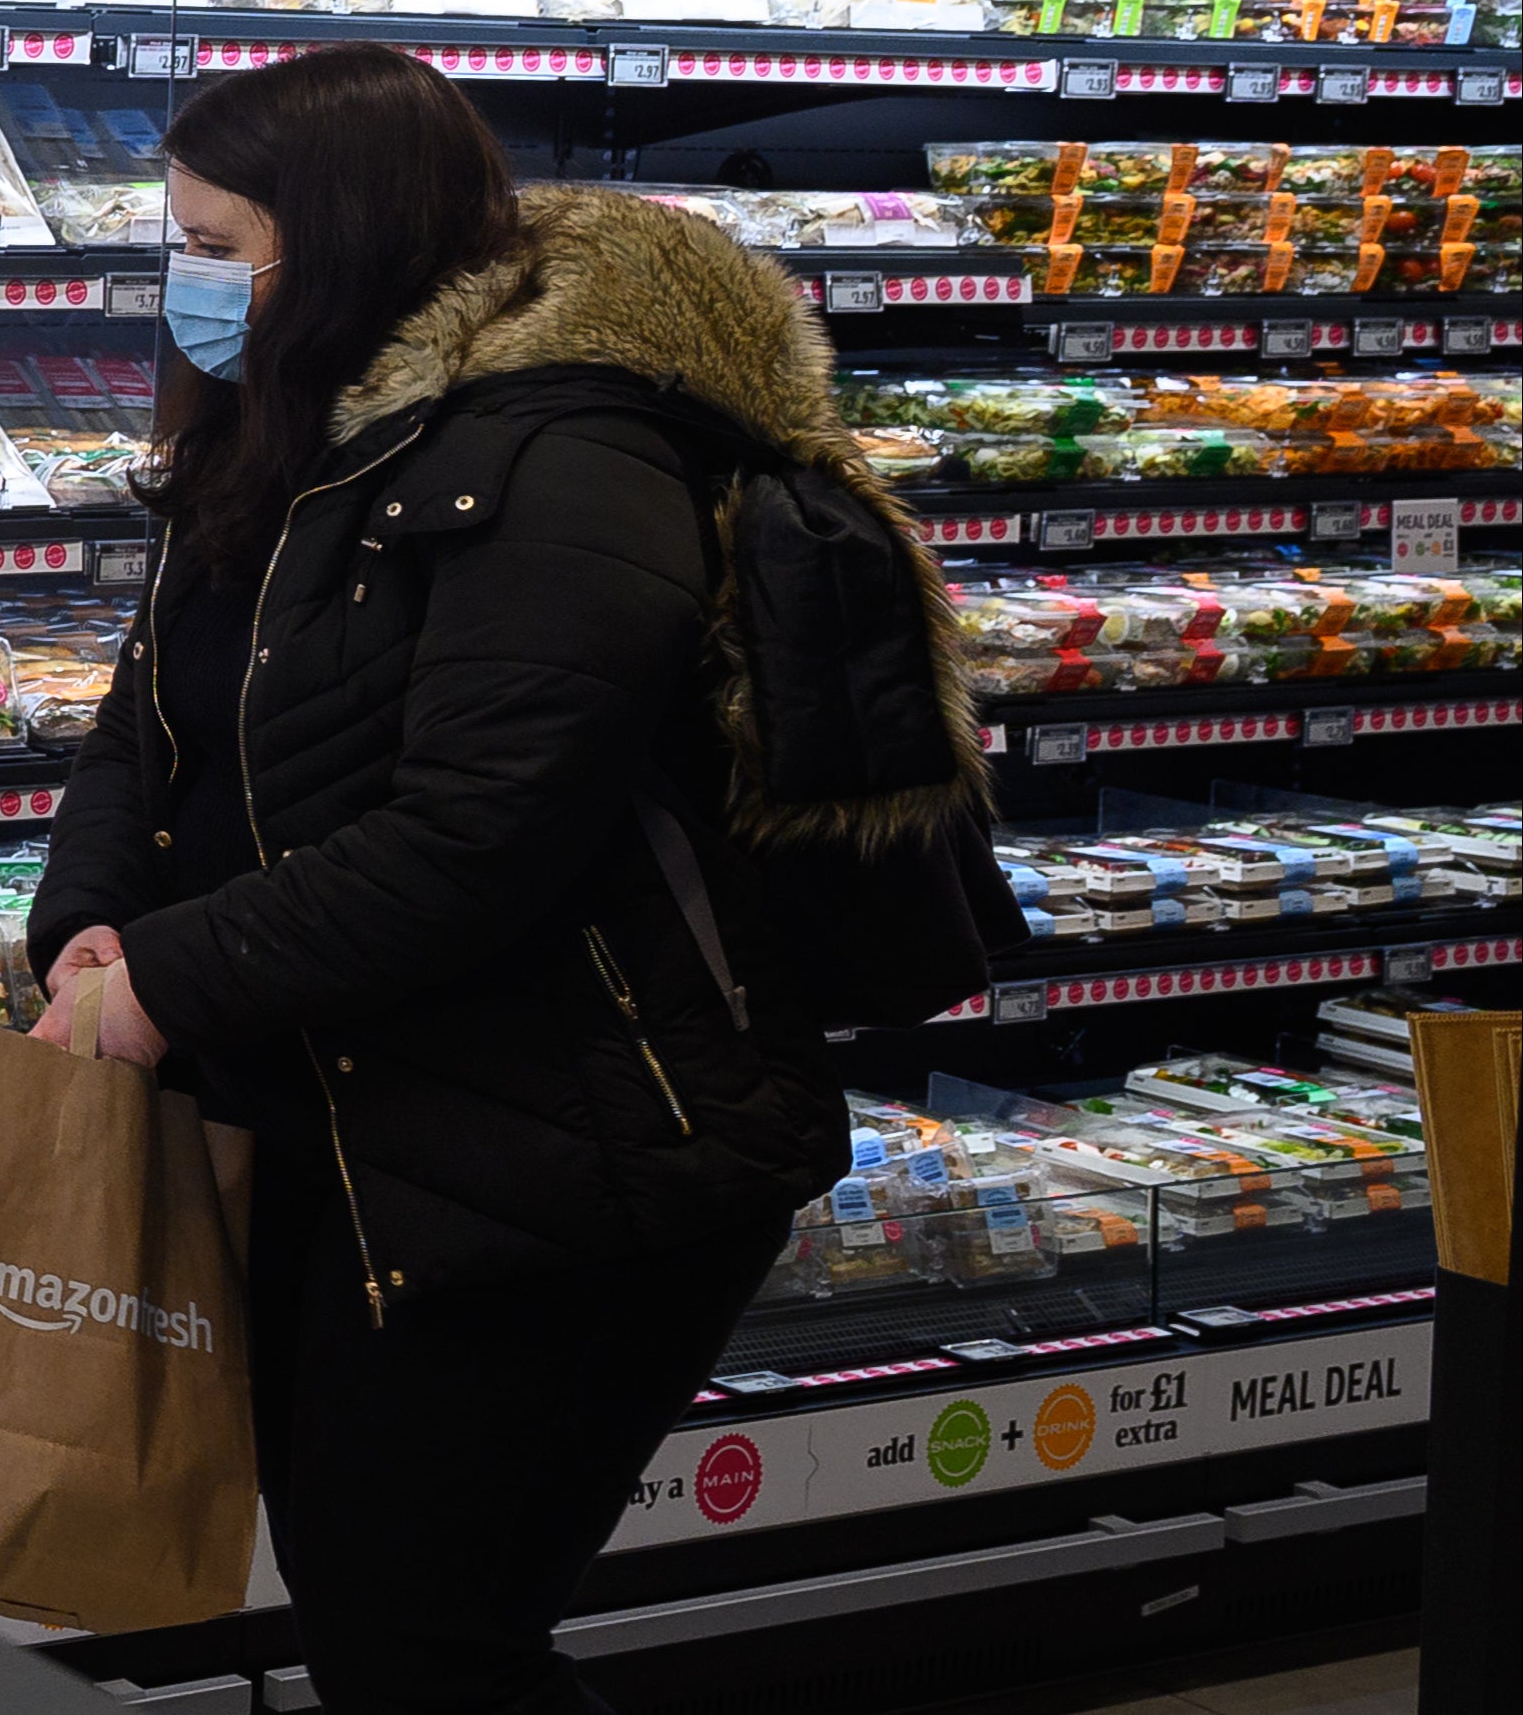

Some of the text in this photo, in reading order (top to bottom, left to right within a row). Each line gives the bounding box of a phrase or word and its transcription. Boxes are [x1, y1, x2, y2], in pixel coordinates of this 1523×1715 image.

[1395, 513, 1424, 531] MEAL
[1229, 1357, 1402, 1423] MEAL DEAL
[866, 1433, 916, 1469] add
[930, 1433, 987, 1454] SNACK
[1036, 1419, 1091, 1437] DRINK
[1109, 1384, 1145, 1414] for
[1148, 1369, 1189, 1412] £1
[1114, 1418, 1179, 1449] extra
[667, 1475, 684, 1500] a
[702, 1468, 755, 1490] MAIN
